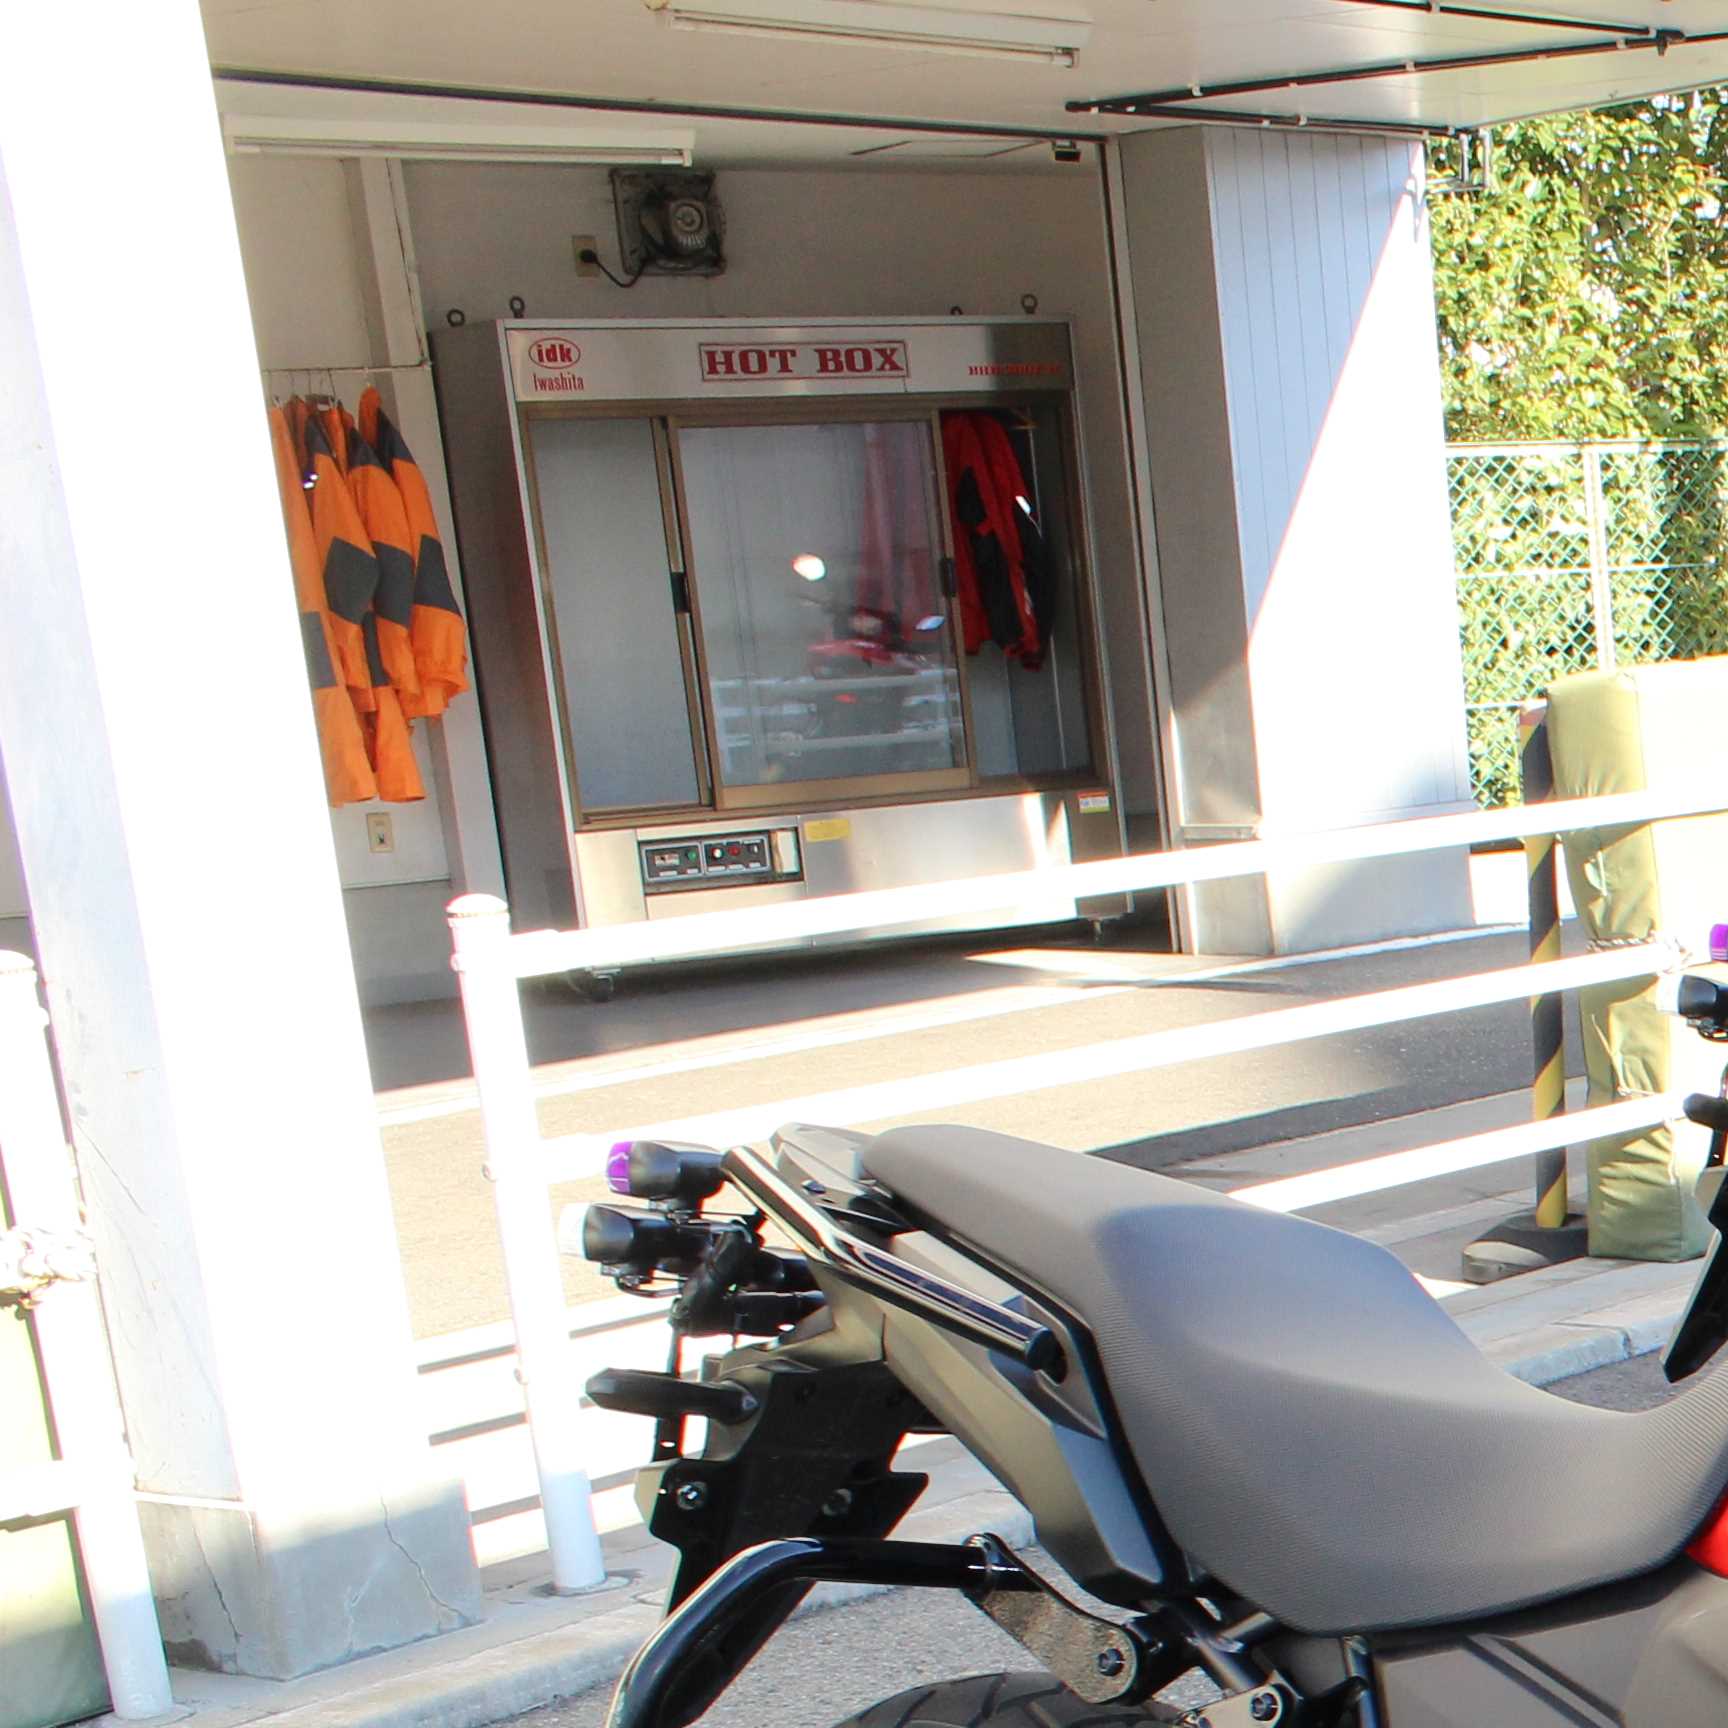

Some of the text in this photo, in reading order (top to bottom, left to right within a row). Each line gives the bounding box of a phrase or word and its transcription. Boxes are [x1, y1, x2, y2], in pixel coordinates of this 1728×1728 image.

[536, 344, 573, 364] idk
[704, 347, 905, 375] HOT BOX
[532, 371, 584, 393] Iwashita
